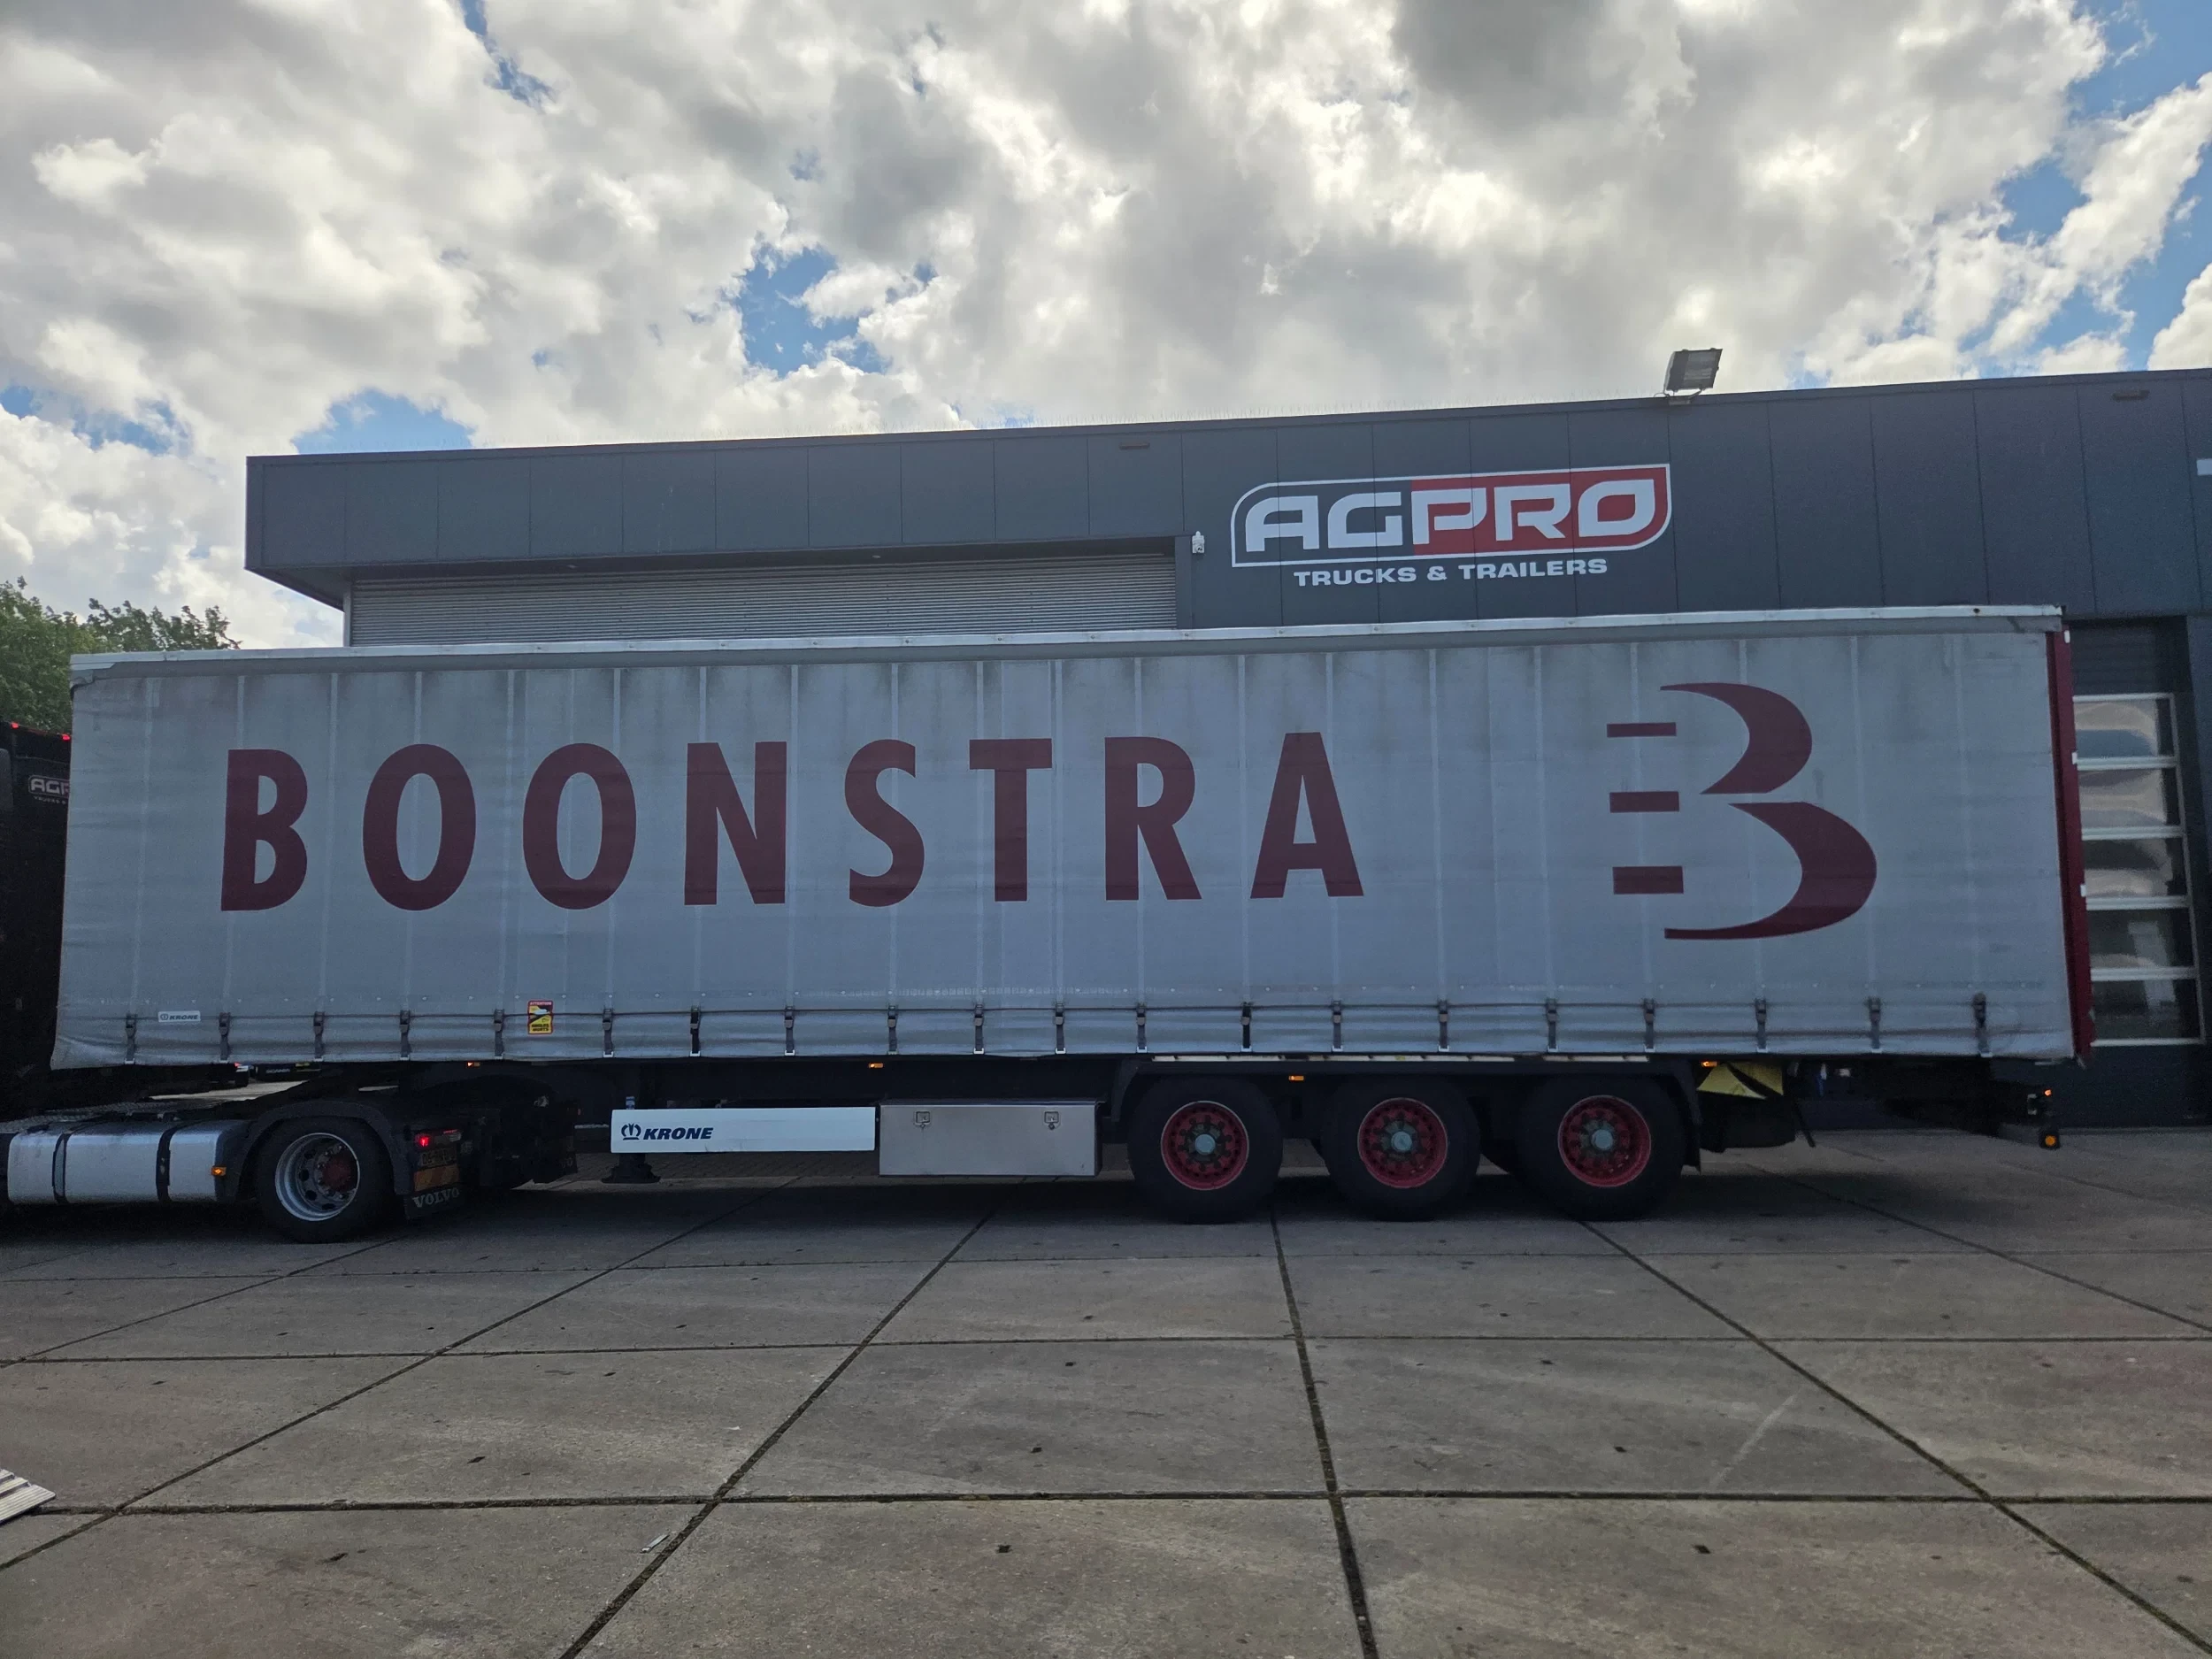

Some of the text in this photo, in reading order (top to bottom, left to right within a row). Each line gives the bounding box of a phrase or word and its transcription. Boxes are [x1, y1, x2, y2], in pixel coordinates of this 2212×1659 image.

[1245, 478, 1655, 553] AGPRO
[1294, 557, 1609, 587] TRUCKS & TRAILERS
[221, 732, 1364, 911] BOONSTRA
[643, 1127, 714, 1141] KRONE
[411, 1187, 460, 1209] VOLVO
